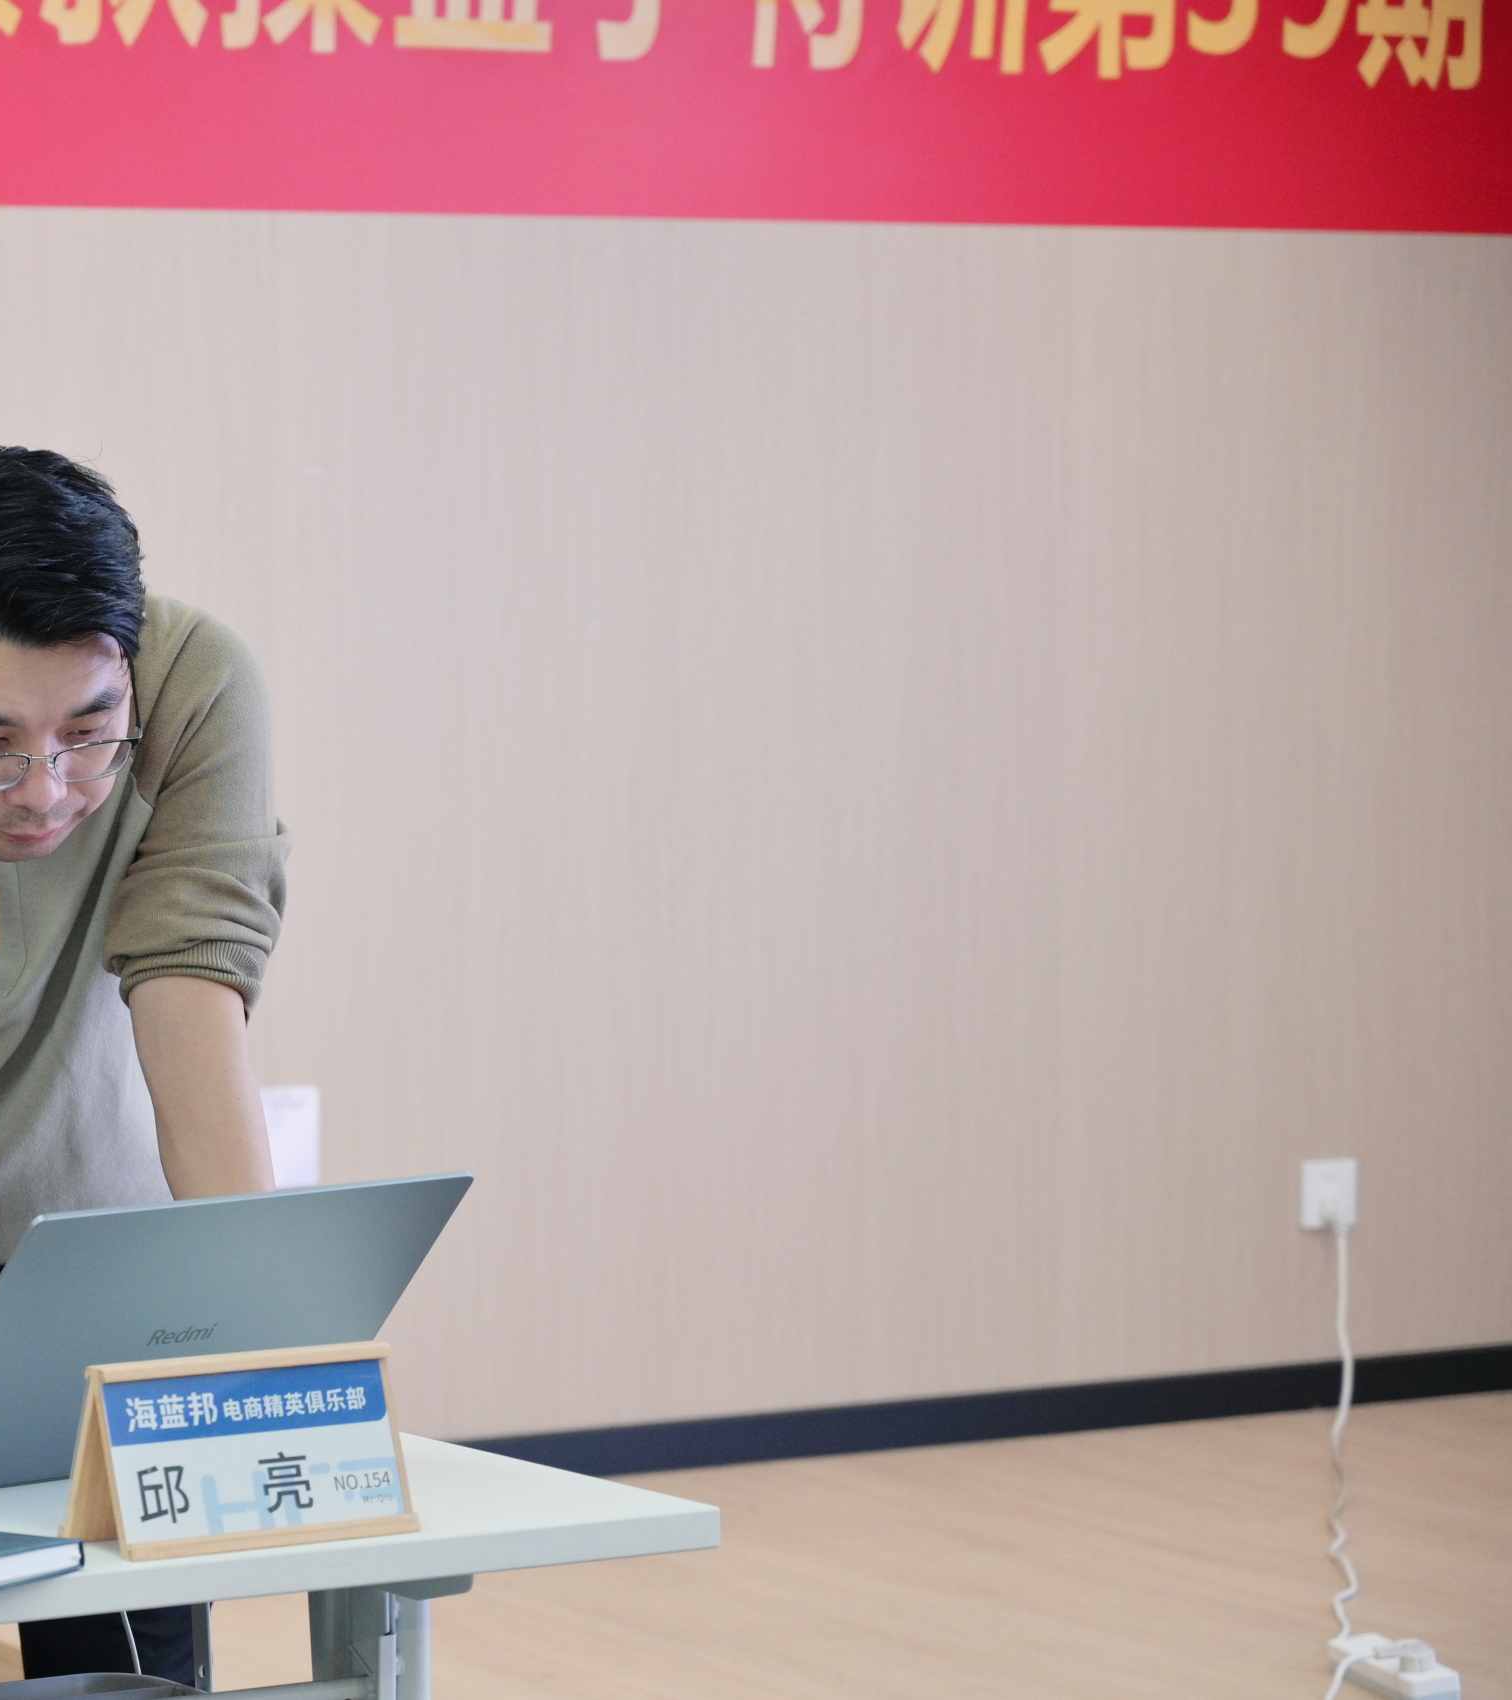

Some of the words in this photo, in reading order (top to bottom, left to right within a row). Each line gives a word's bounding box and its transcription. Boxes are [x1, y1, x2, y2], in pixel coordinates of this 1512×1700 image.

[145, 1322, 218, 1346] Redmi
[125, 1391, 218, 1432] 海蓝邦
[222, 1386, 366, 1422] 电商精英俱乐部
[137, 1464, 190, 1523] 邱
[257, 1451, 314, 1513] 亮
[333, 1471, 391, 1491] NO.154
